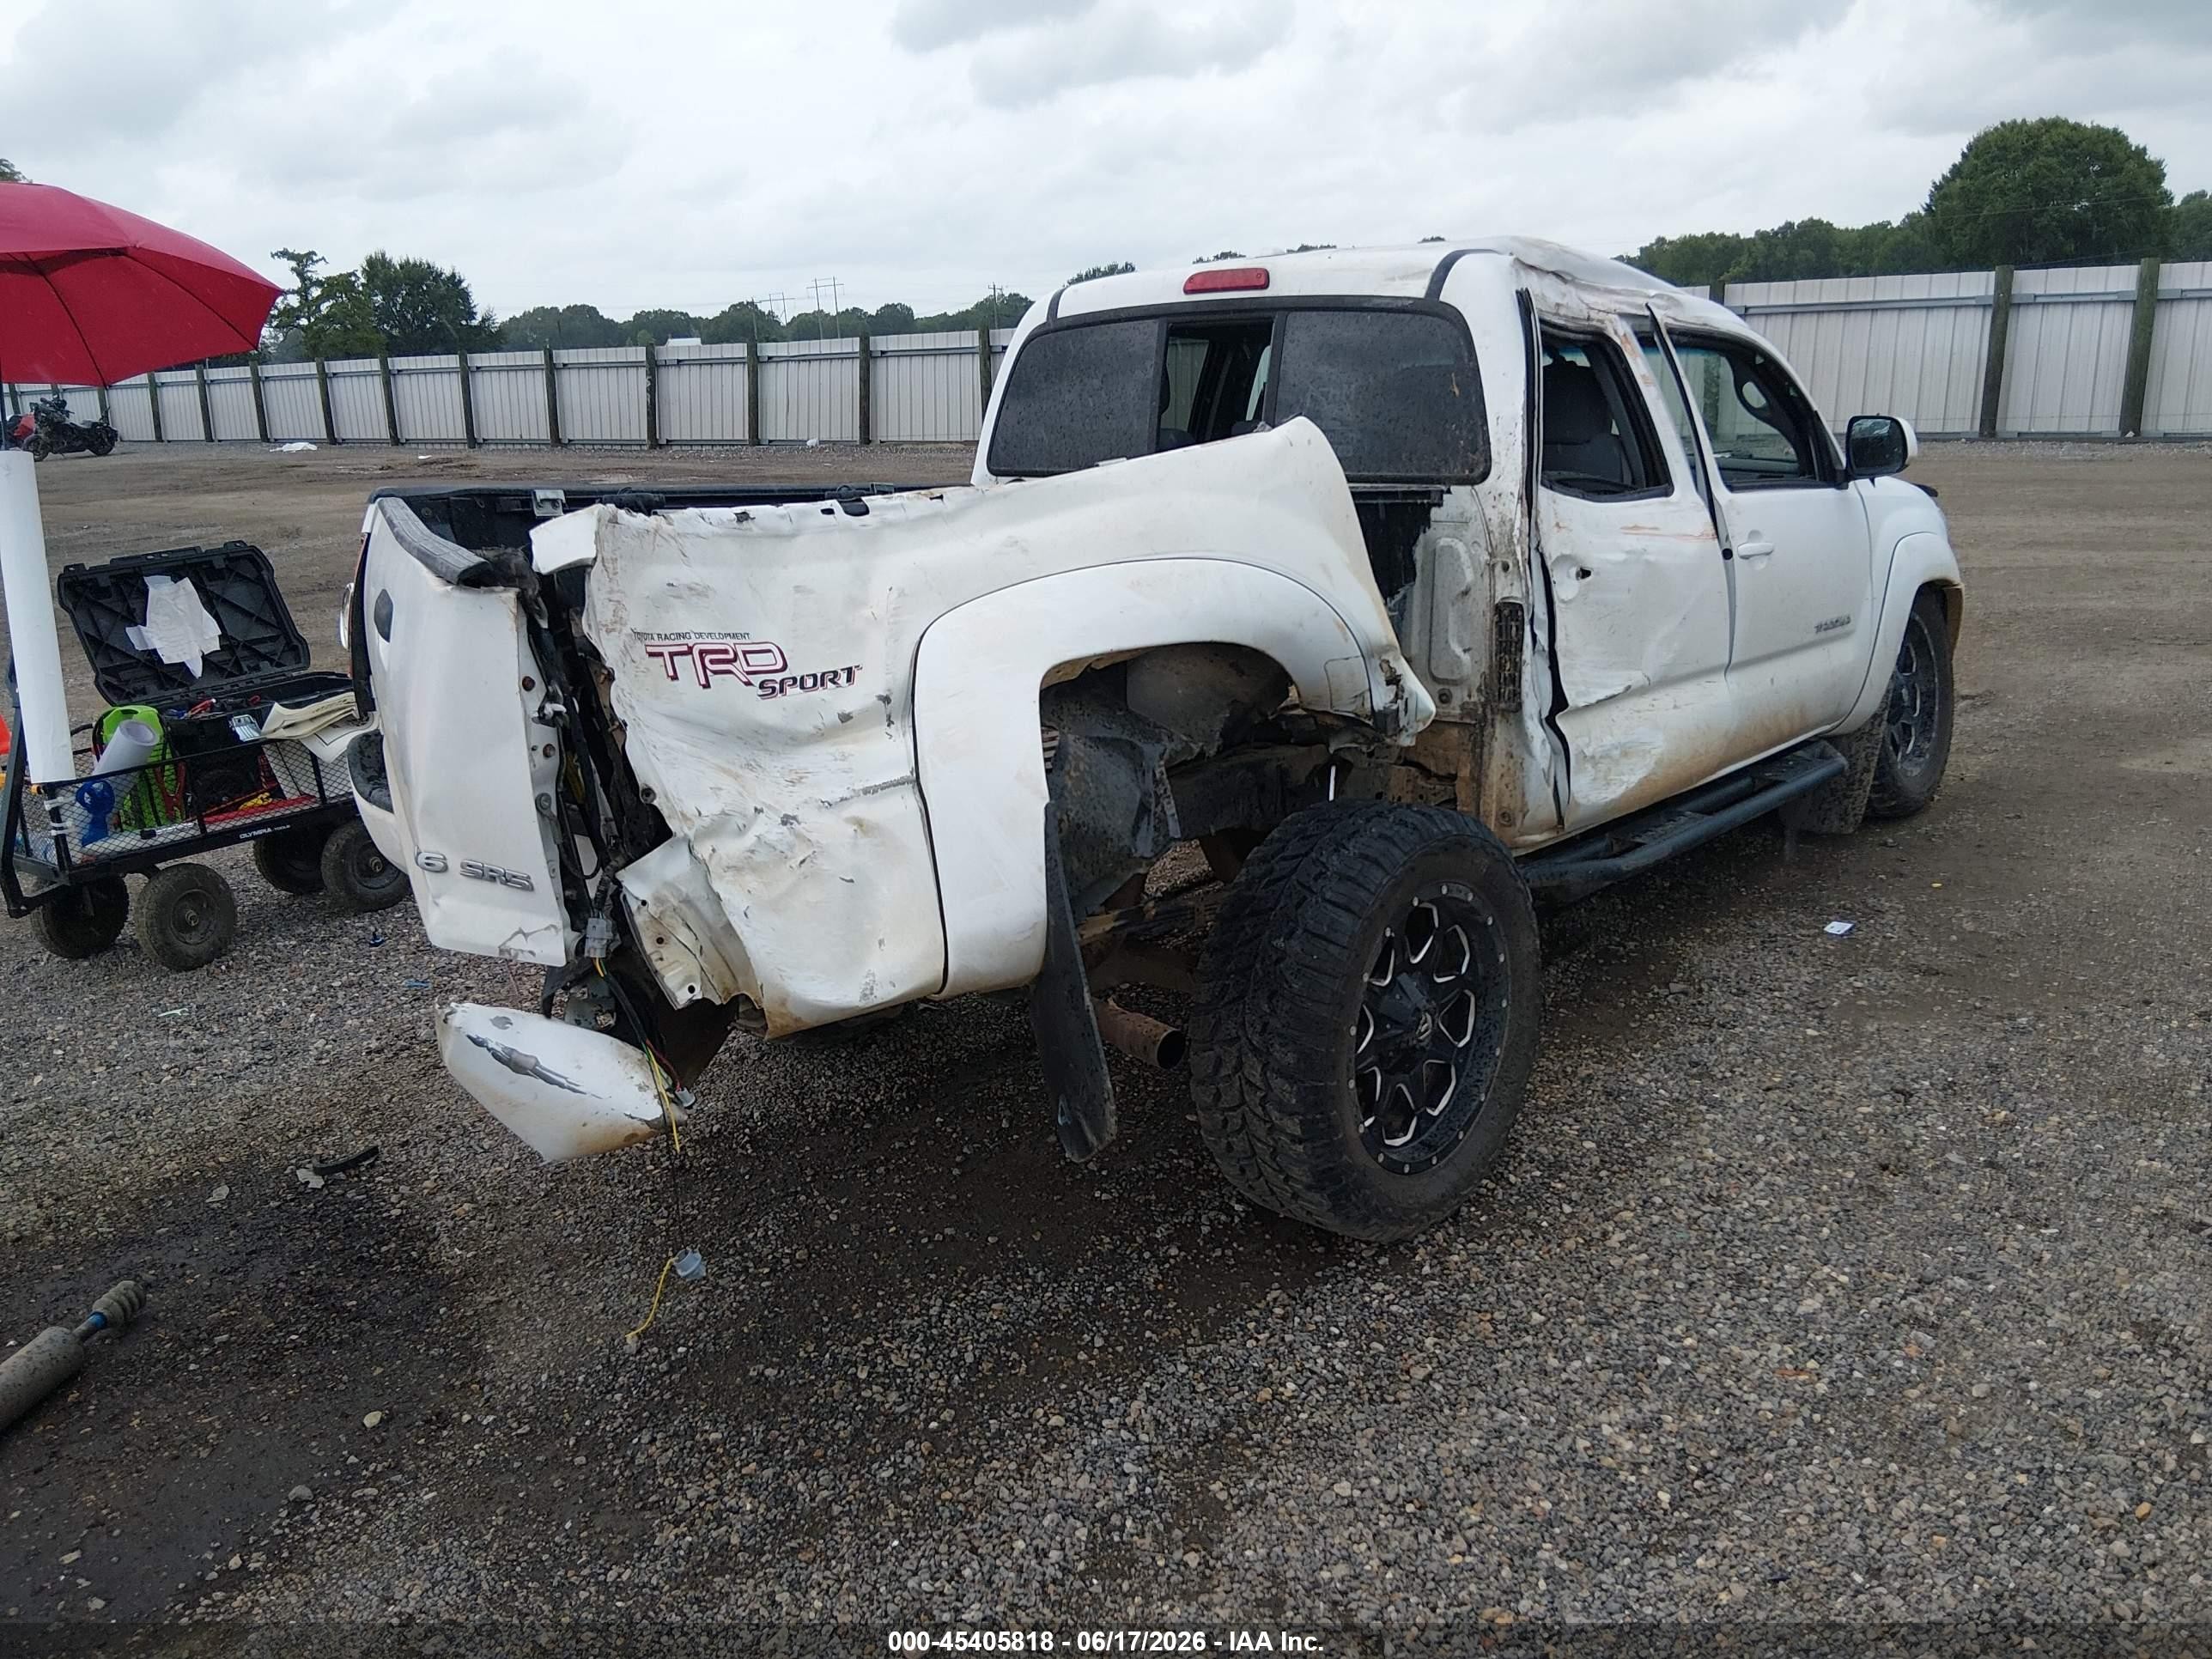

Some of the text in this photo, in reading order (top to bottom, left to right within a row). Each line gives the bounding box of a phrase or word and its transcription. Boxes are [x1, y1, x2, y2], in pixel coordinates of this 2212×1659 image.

[657, 632, 692, 641] RACING
[692, 631, 750, 641] DEVELOPMENT
[645, 641, 788, 690] TRD
[757, 665, 863, 700] SPORT
[459, 859, 535, 892] SR5
